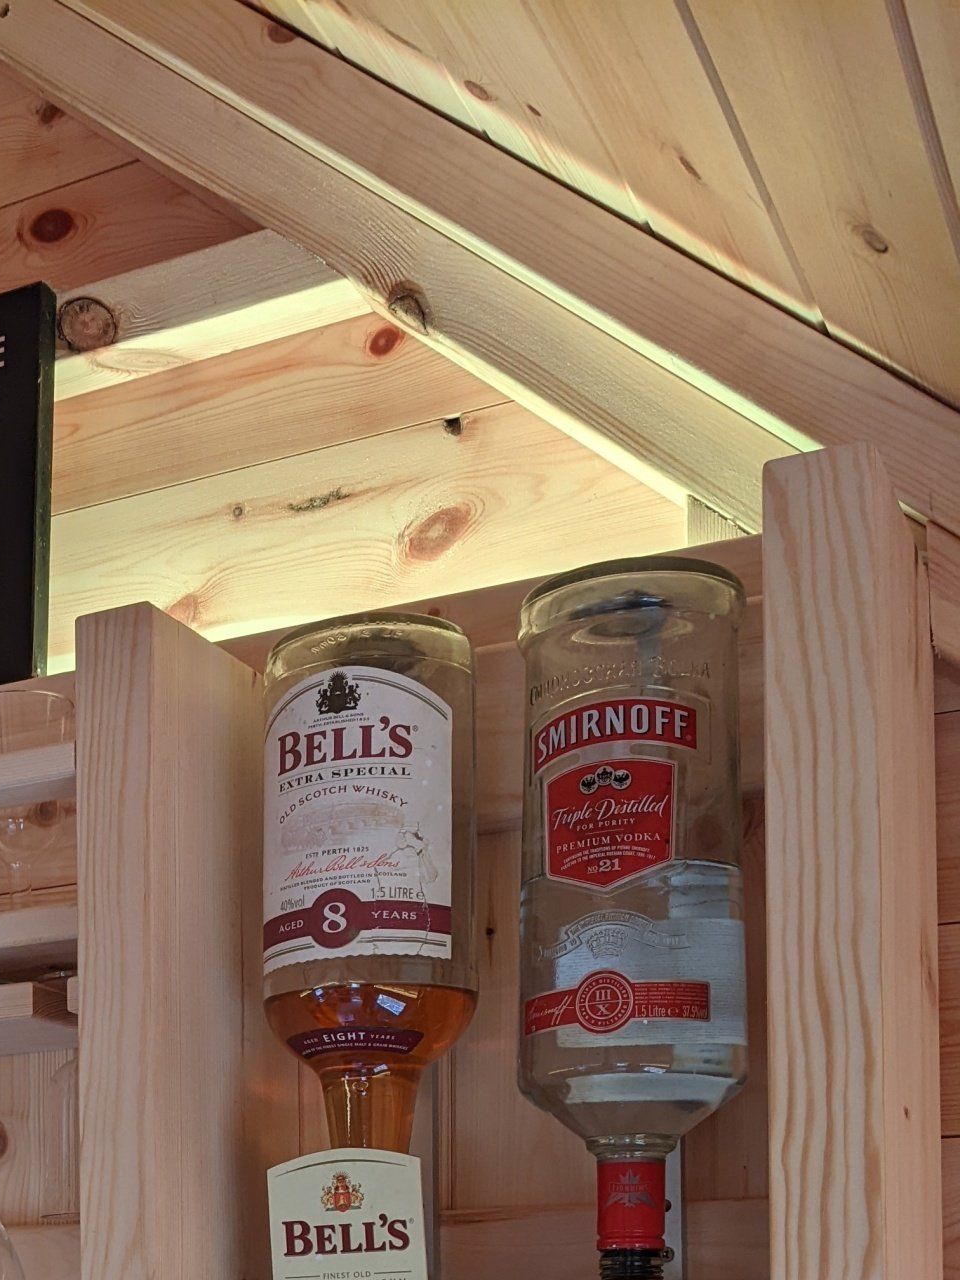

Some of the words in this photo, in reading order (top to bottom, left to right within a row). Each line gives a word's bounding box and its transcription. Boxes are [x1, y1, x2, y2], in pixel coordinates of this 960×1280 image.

[537, 704, 690, 763] SMIRNOFF
[278, 716, 413, 776] BELL'S
[279, 772, 325, 792] EXTRA
[331, 766, 411, 779] SPECIAL
[279, 803, 296, 824] OLD
[298, 785, 347, 806] SCOTCH
[352, 784, 408, 807] WHISKY
[553, 801, 593, 831] Triple
[595, 794, 669, 821] Distilled
[576, 823, 594, 831] FOR
[598, 818, 636, 827] PURITY
[322, 847, 350, 856] PERTH
[556, 836, 610, 854] PREMIUM
[615, 832, 661, 842] VODKA
[599, 859, 621, 872] 21
[389, 887, 414, 899] LITRE
[278, 919, 304, 934] AGED
[322, 902, 347, 933] 8
[371, 910, 417, 920] YEARS
[595, 1004, 611, 1015] X
[634, 1004, 647, 1017] 1.5
[649, 1004, 666, 1017] Litre
[323, 1032, 366, 1043] EIGHT
[282, 1213, 410, 1257] BELL'S
[323, 1272, 351, 1280] FINEST
[353, 1271, 371, 1279] OLD
